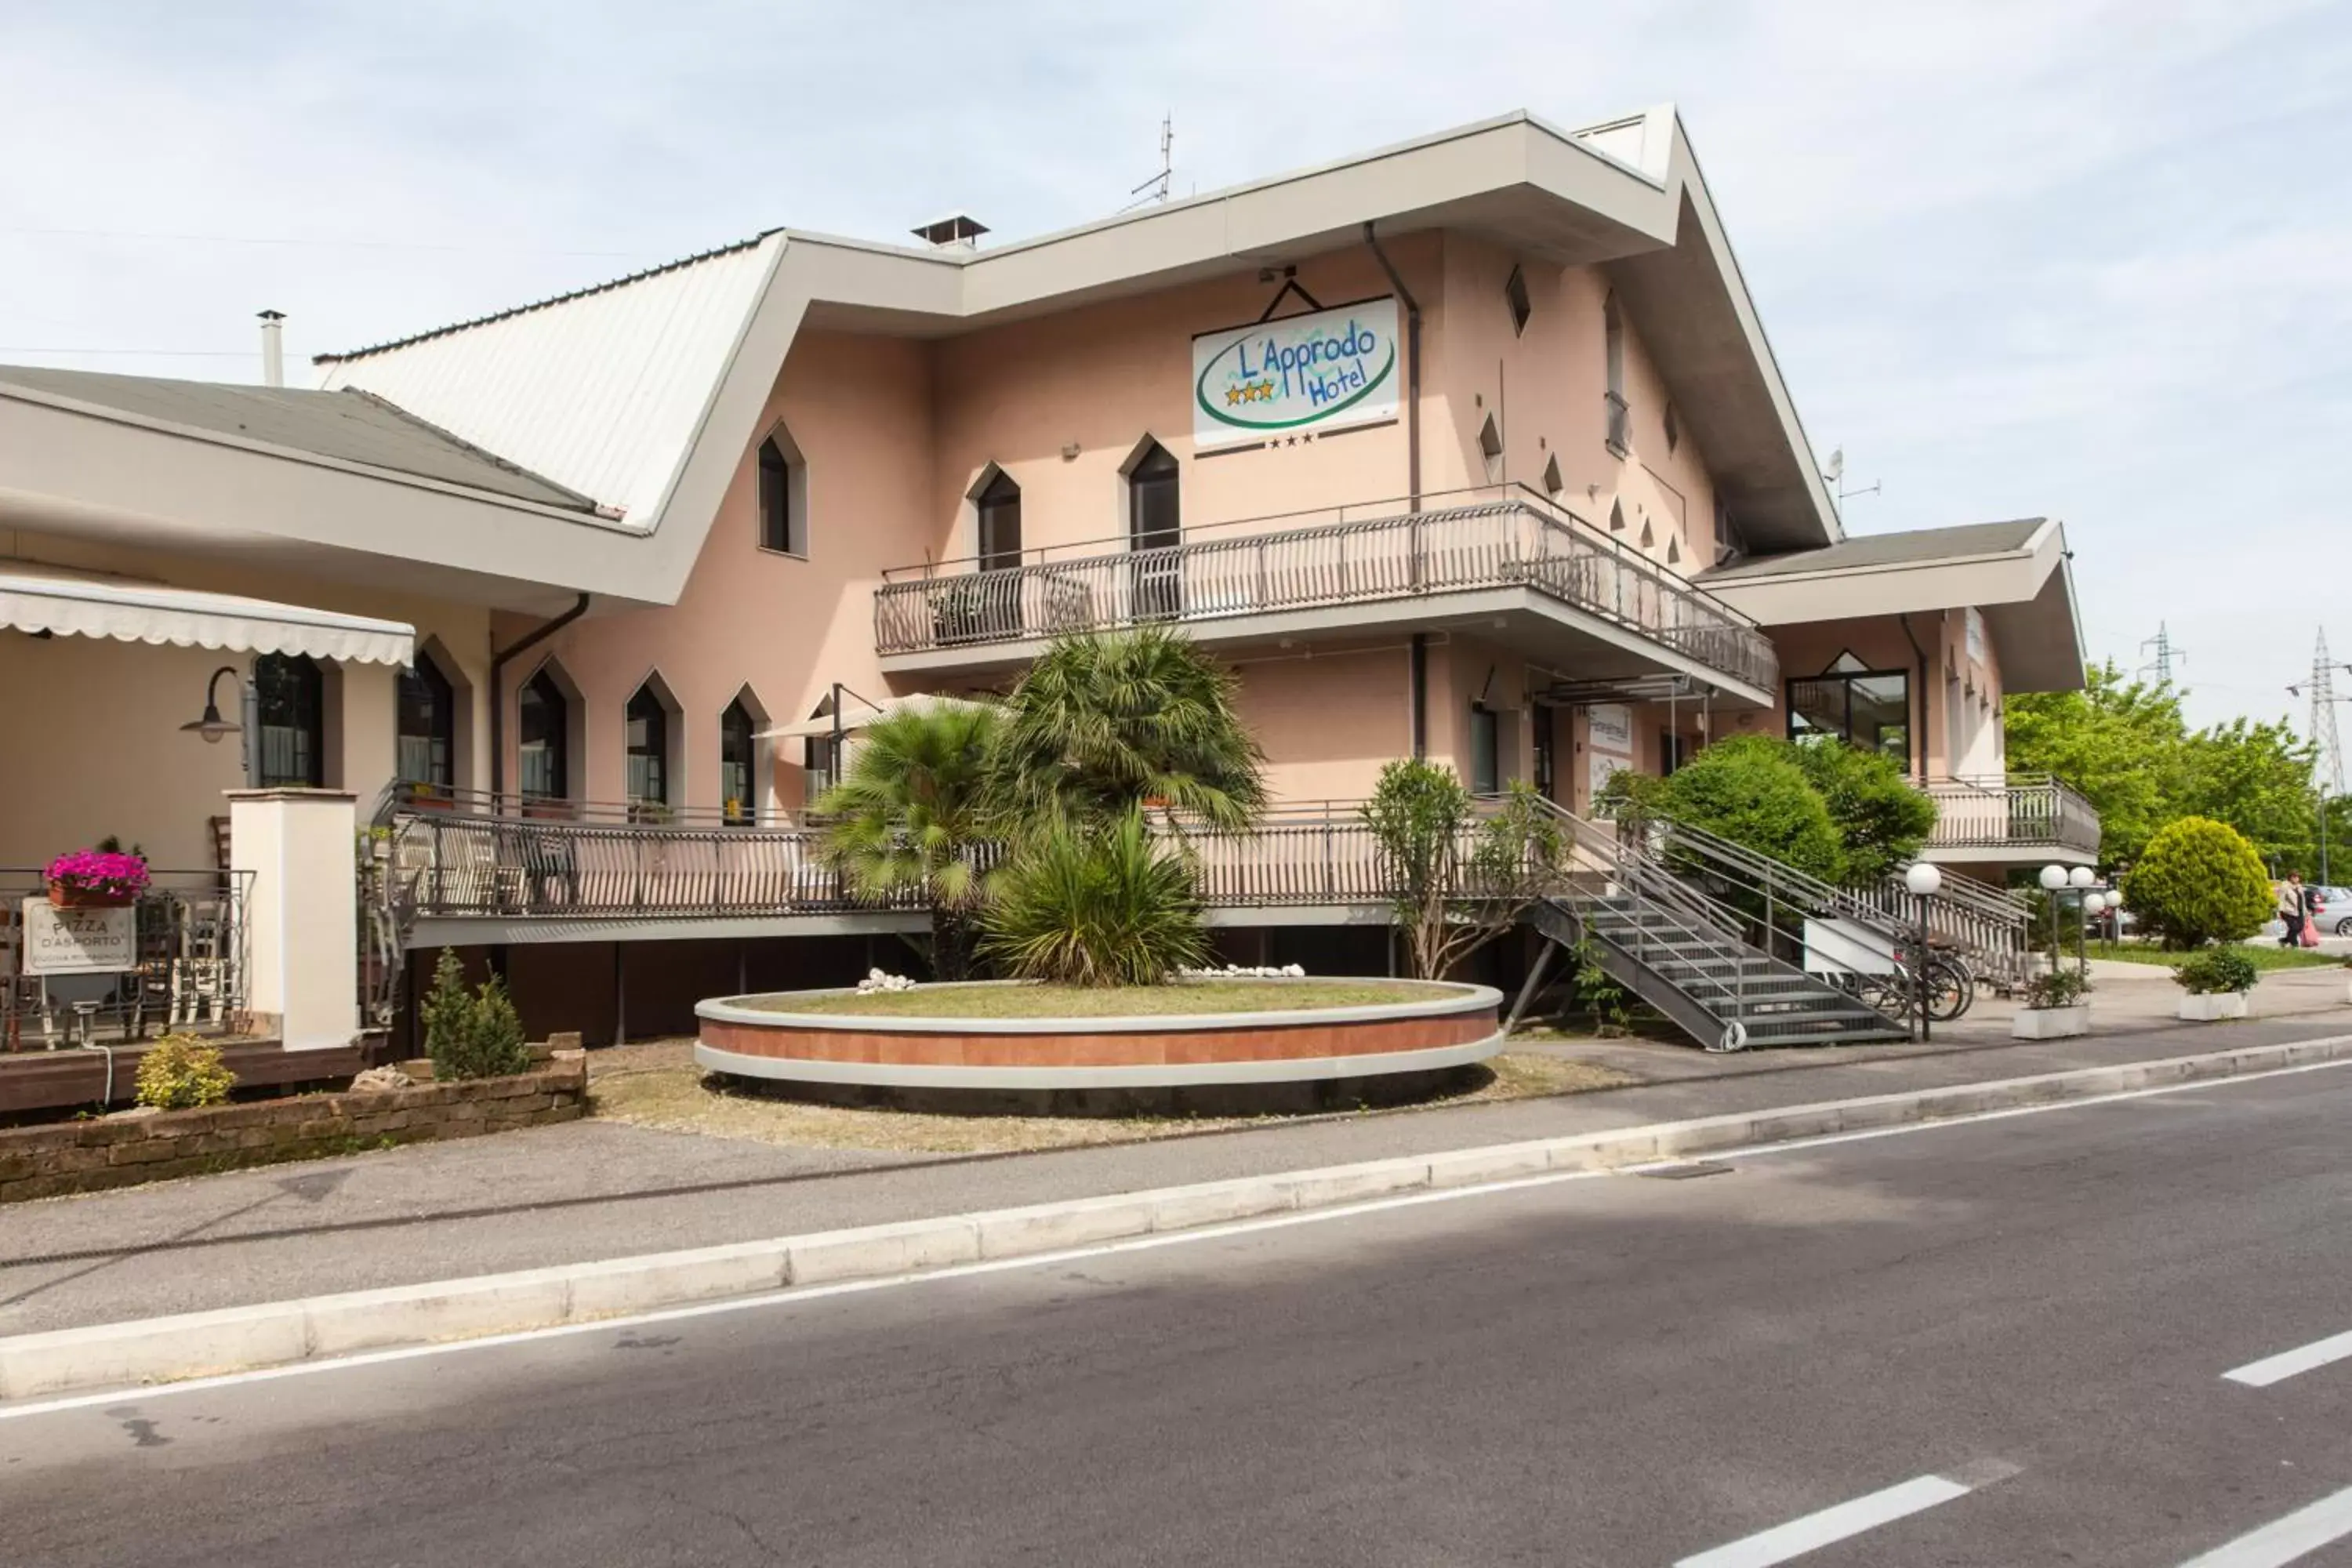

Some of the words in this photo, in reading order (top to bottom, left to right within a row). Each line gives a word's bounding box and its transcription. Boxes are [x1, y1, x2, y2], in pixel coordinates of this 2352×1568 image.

[1239, 319, 1375, 398] L'Approdo
[1308, 358, 1367, 406] Hotel
[53, 919, 108, 935] PIZZA
